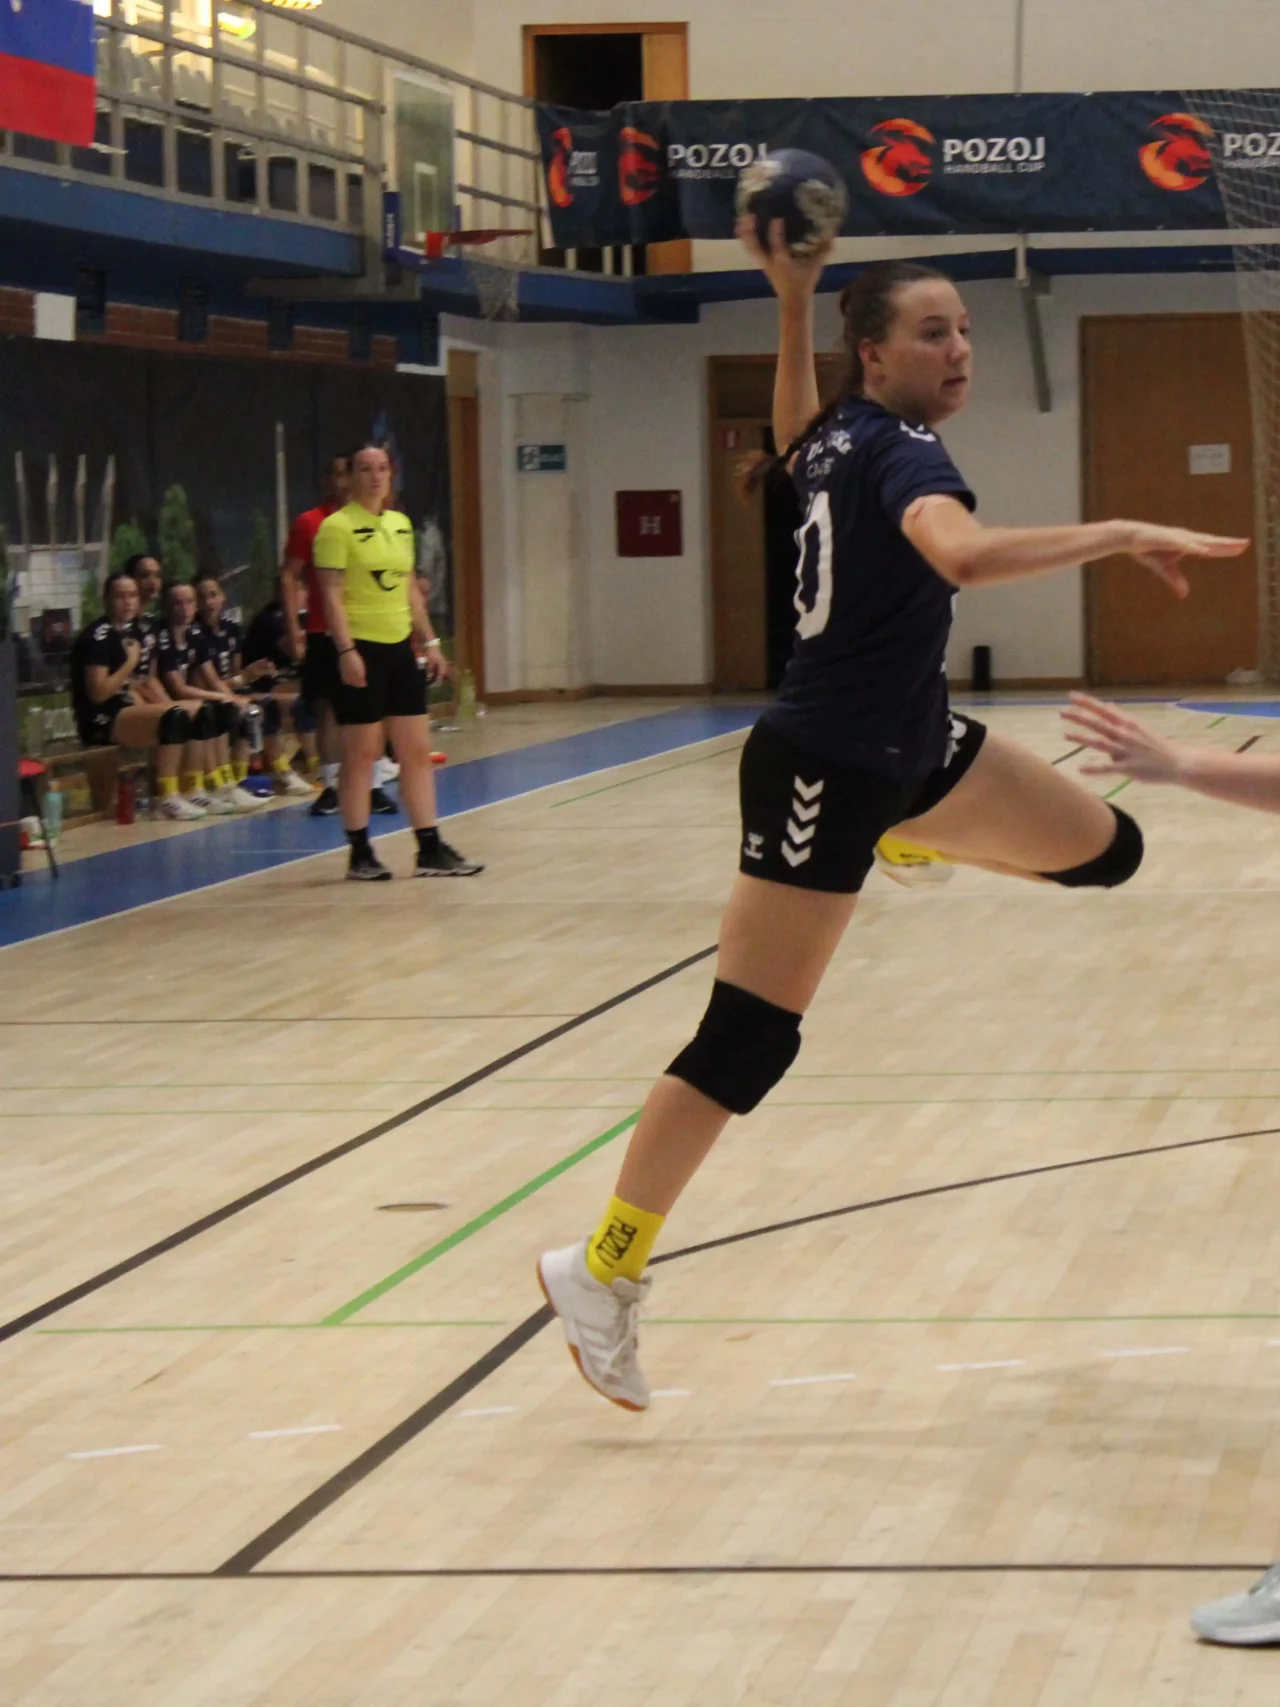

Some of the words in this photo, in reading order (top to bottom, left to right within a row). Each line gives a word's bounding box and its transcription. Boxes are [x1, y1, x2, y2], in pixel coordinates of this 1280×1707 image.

[943, 137, 1045, 162] POZOJ
[1017, 162, 1045, 173] CUP
[639, 515, 661, 535] H
